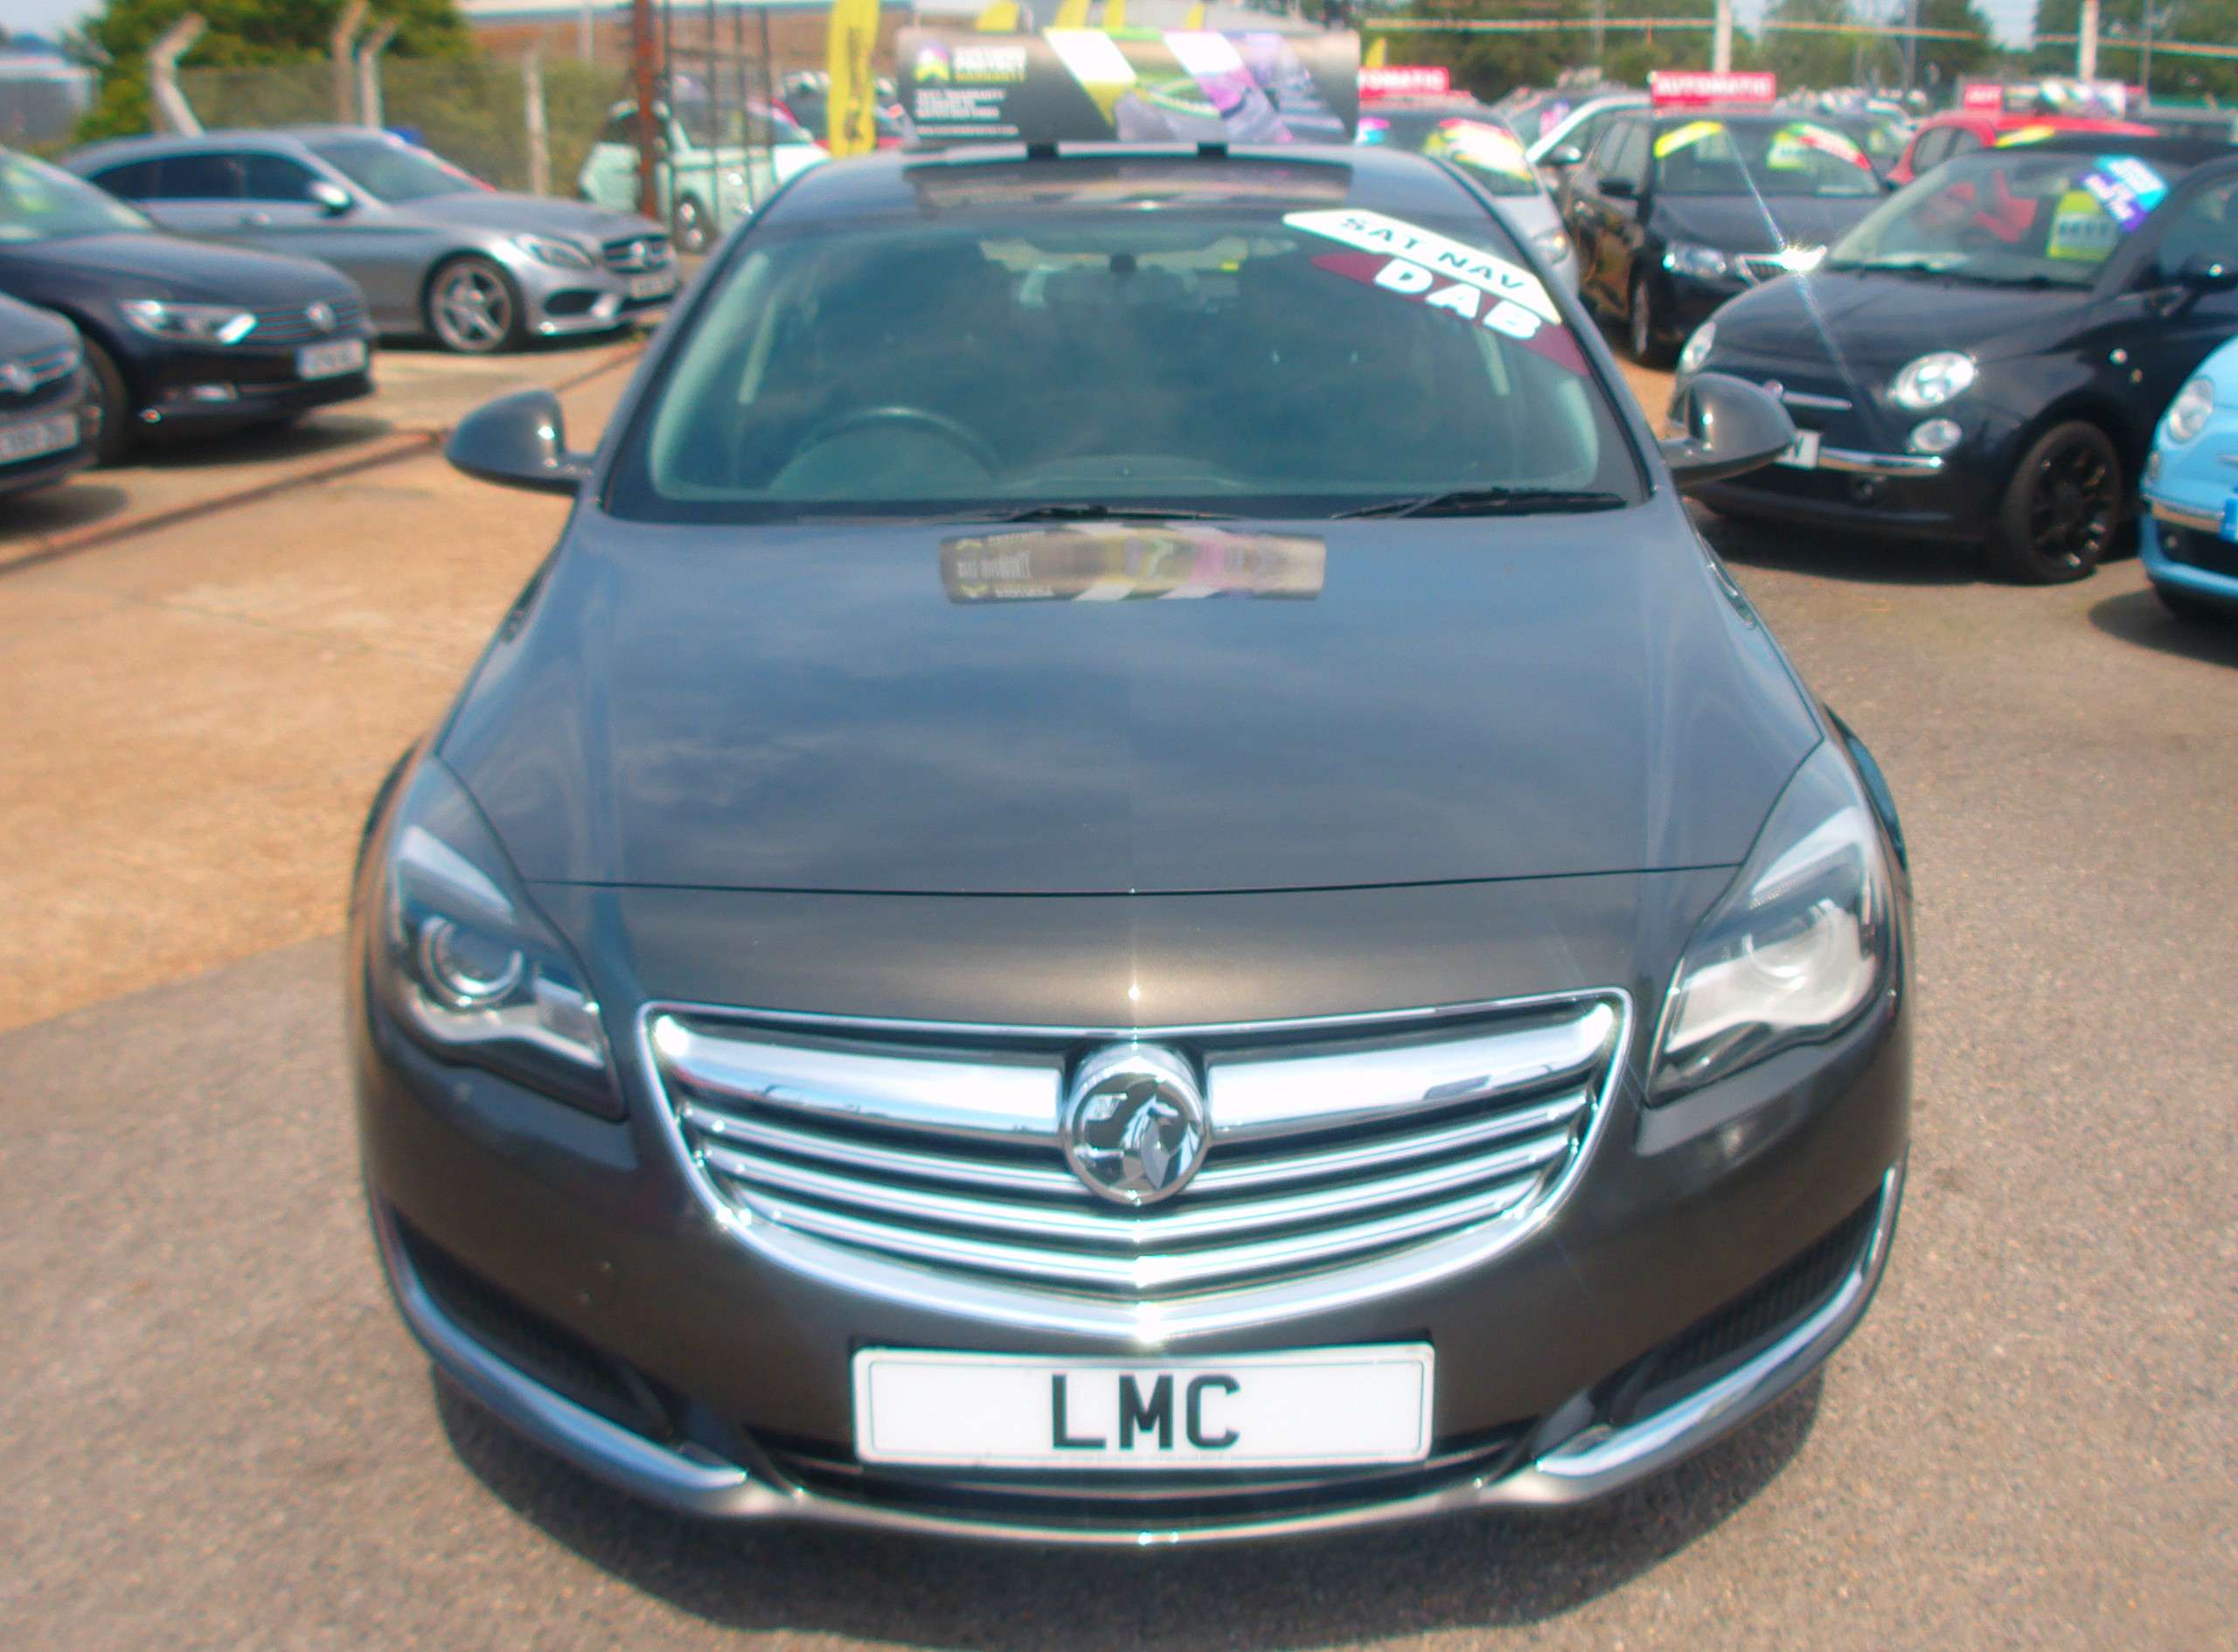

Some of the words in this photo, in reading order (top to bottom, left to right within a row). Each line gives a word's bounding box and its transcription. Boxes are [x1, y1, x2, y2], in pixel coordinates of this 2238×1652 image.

[1340, 218, 1421, 250] SAT
[1437, 251, 1525, 290] NAV
[1373, 257, 1542, 340] DAB
[1051, 1373, 1241, 1451] LMC
